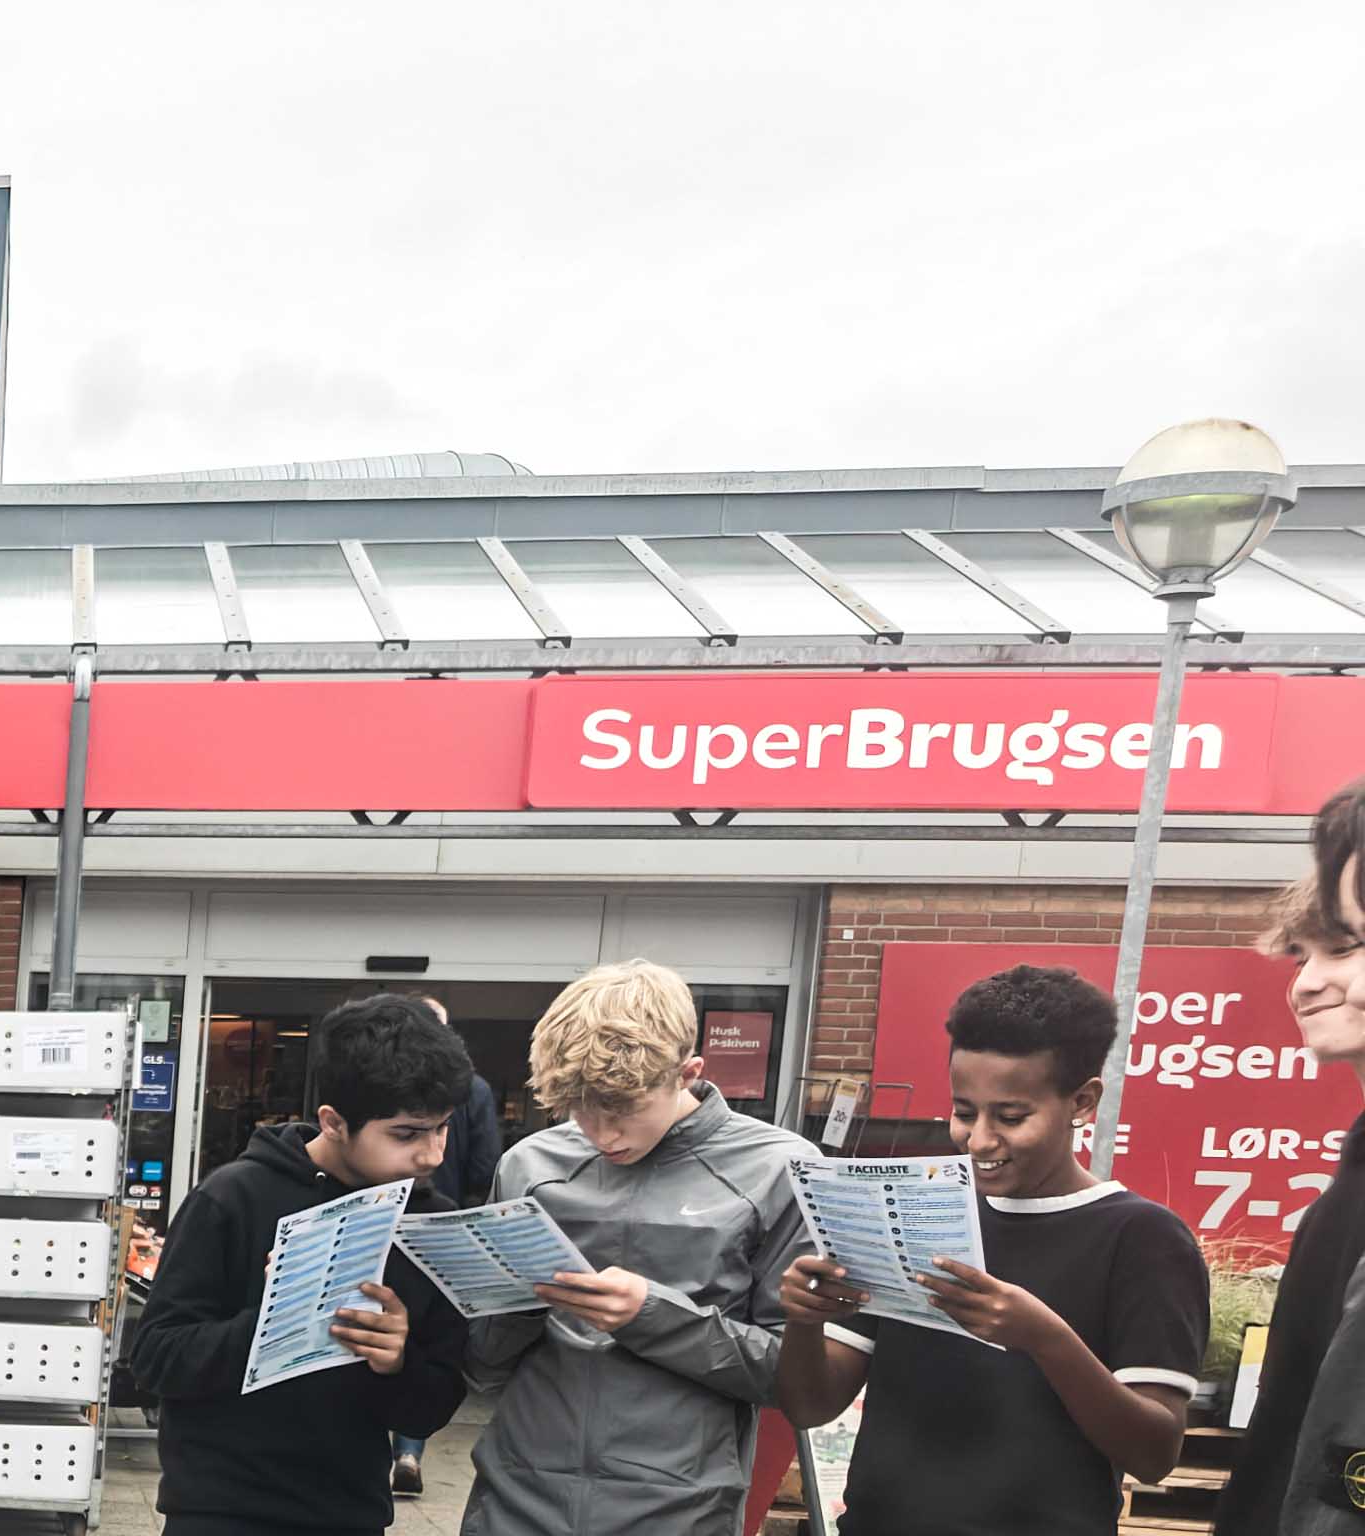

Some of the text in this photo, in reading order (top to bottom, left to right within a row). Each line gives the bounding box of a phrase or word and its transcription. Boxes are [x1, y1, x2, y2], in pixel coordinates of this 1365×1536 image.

[579, 707, 1224, 786] SuperBrugsen
[709, 1026, 741, 1037] Husk
[1130, 991, 1242, 1034] per
[709, 1038, 761, 1048] P-skiven
[1125, 1035, 1319, 1089] ugsen
[1071, 1123, 1348, 1162] RE LØR-S
[847, 1164, 910, 1175] FACITLISTE
[1193, 1169, 1335, 1232] 7-2
